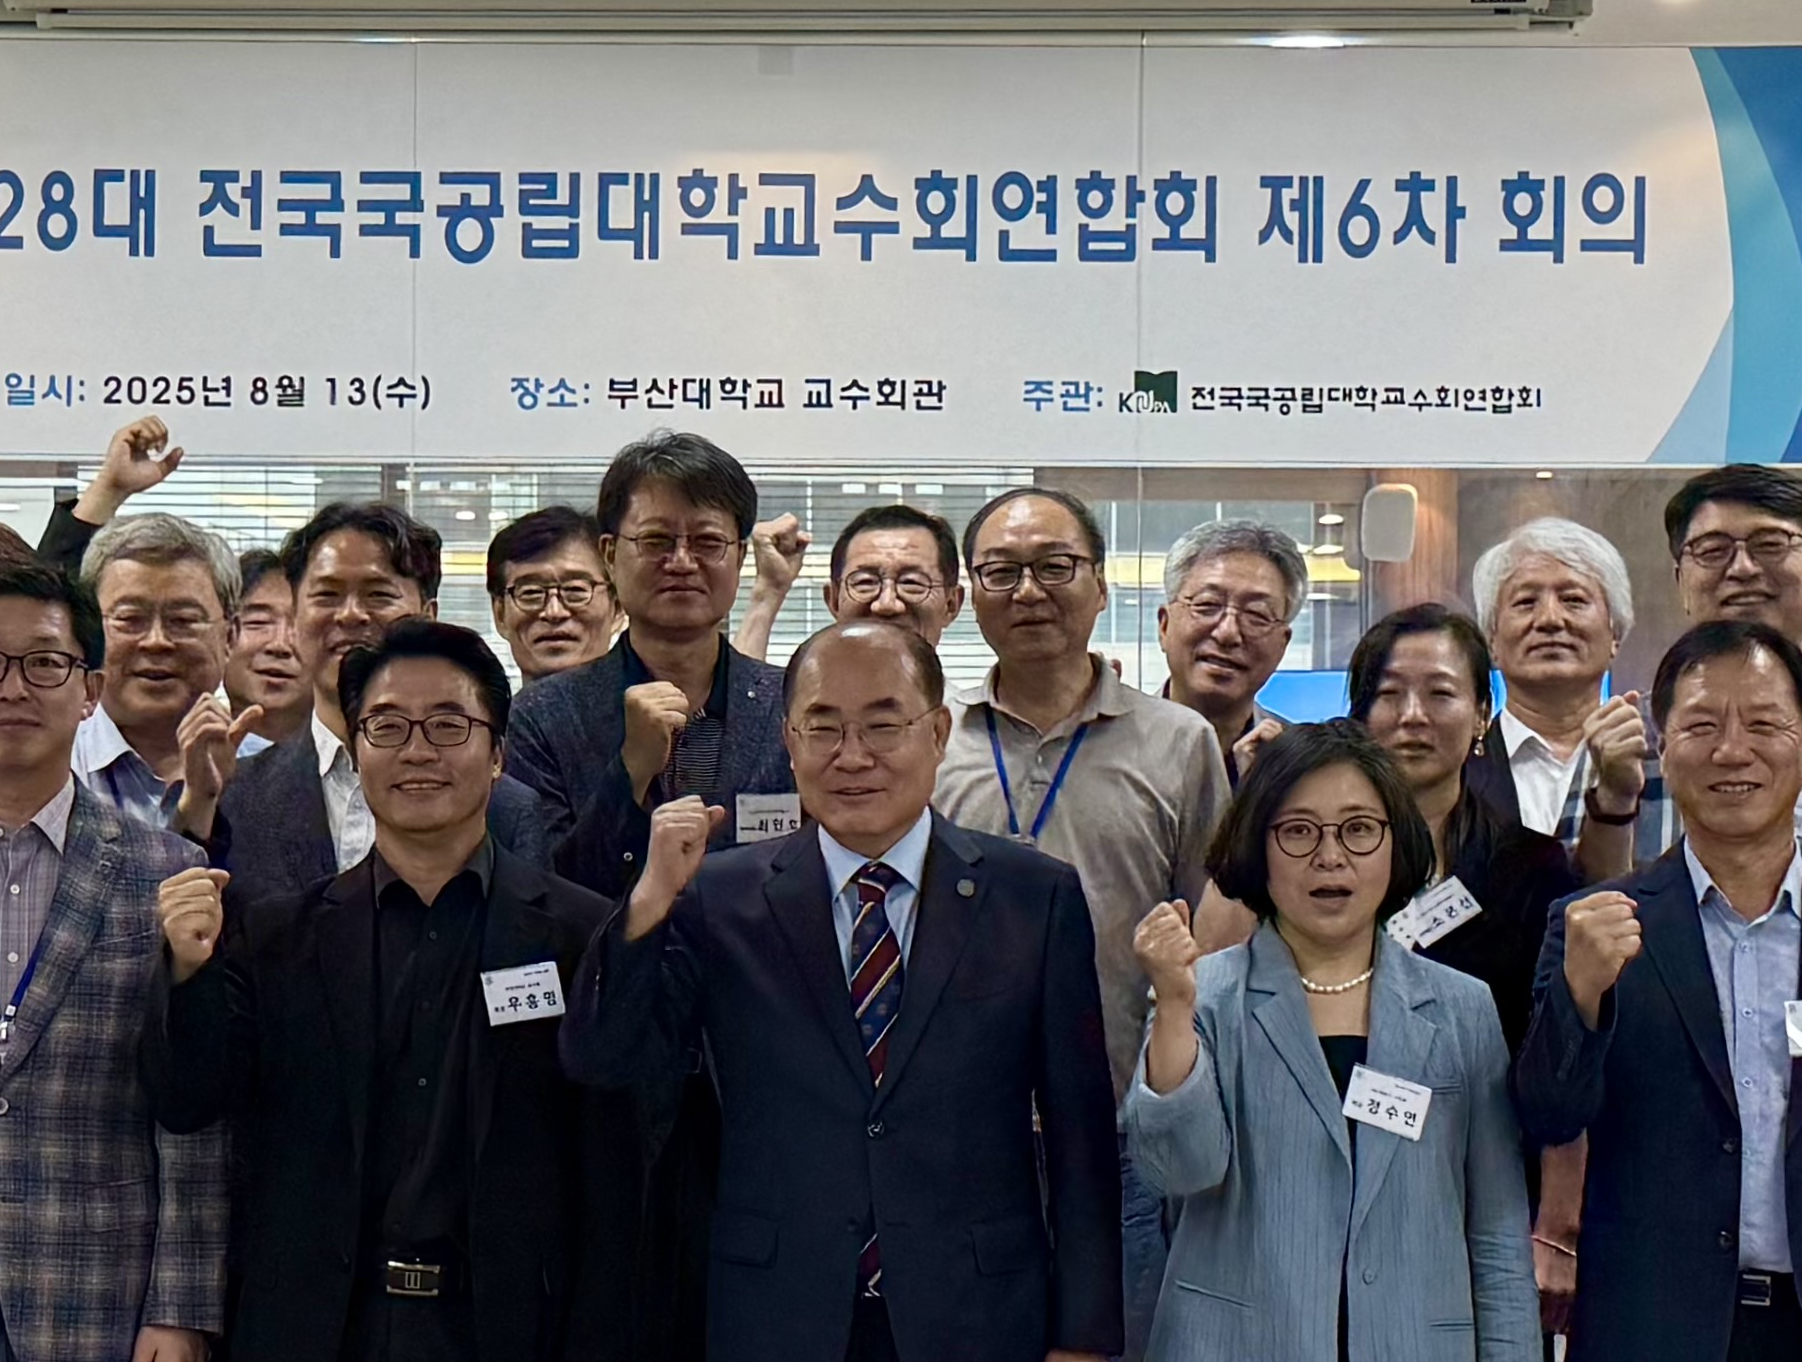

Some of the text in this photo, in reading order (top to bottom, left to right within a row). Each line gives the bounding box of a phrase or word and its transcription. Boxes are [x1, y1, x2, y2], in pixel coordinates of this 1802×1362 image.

[198, 167, 1219, 266] 전국국공립대학교수회연합회
[1257, 170, 1468, 265] 제6차
[1498, 170, 1648, 266] 회의
[5, 373, 87, 409] 일시:
[103, 376, 233, 409] 2025년
[250, 375, 307, 409] 8월
[325, 375, 432, 412] 13(수)
[511, 378, 591, 412] 장소:
[607, 376, 787, 412] 부산대학교
[802, 378, 948, 413] 교수회관
[1023, 381, 1105, 414] 주관:
[1191, 386, 1543, 418] 전국국공립대학교수회연합회
